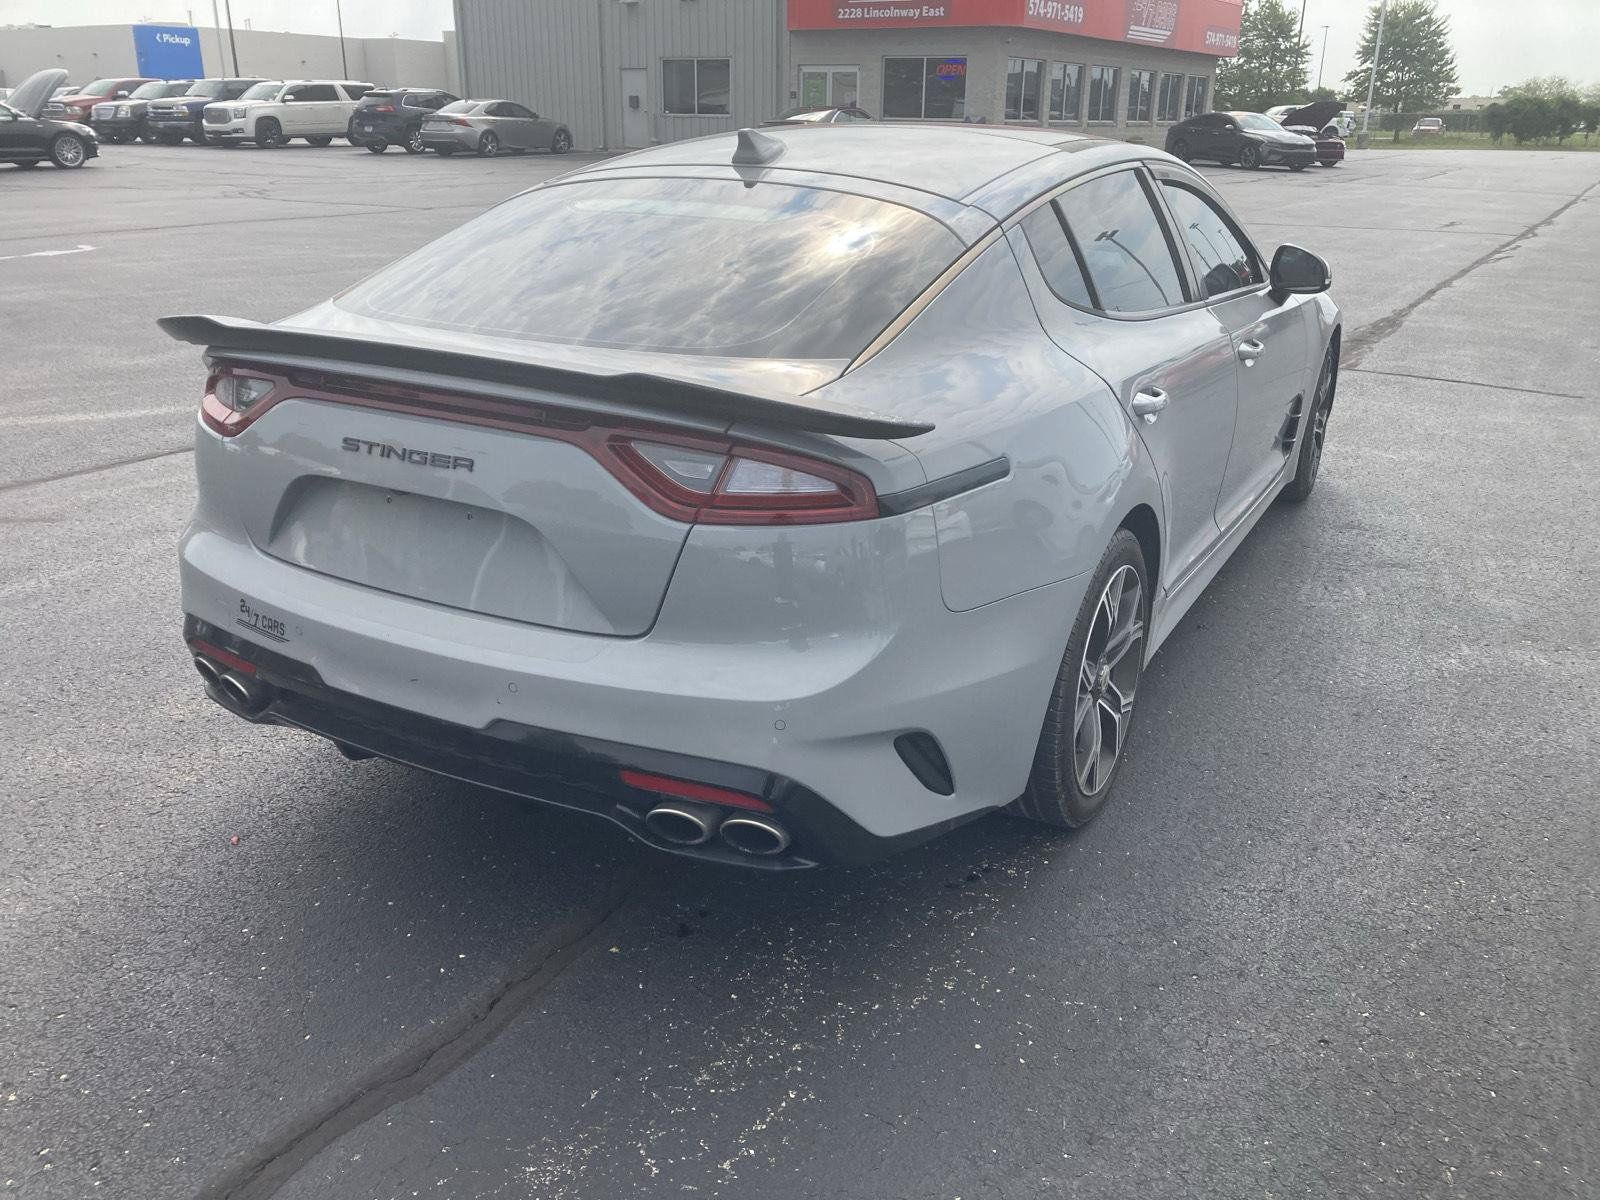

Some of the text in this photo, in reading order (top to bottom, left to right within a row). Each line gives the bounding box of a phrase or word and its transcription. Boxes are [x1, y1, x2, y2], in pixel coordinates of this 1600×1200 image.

[838, 6, 945, 19] 2228 Lincolnway East
[1028, 0, 1084, 24] 574-971-5419
[162, 33, 191, 47] Pickup
[936, 63, 966, 77] OPEN
[341, 436, 475, 473] STINGER
[239, 598, 286, 636] 24/7 CARS
